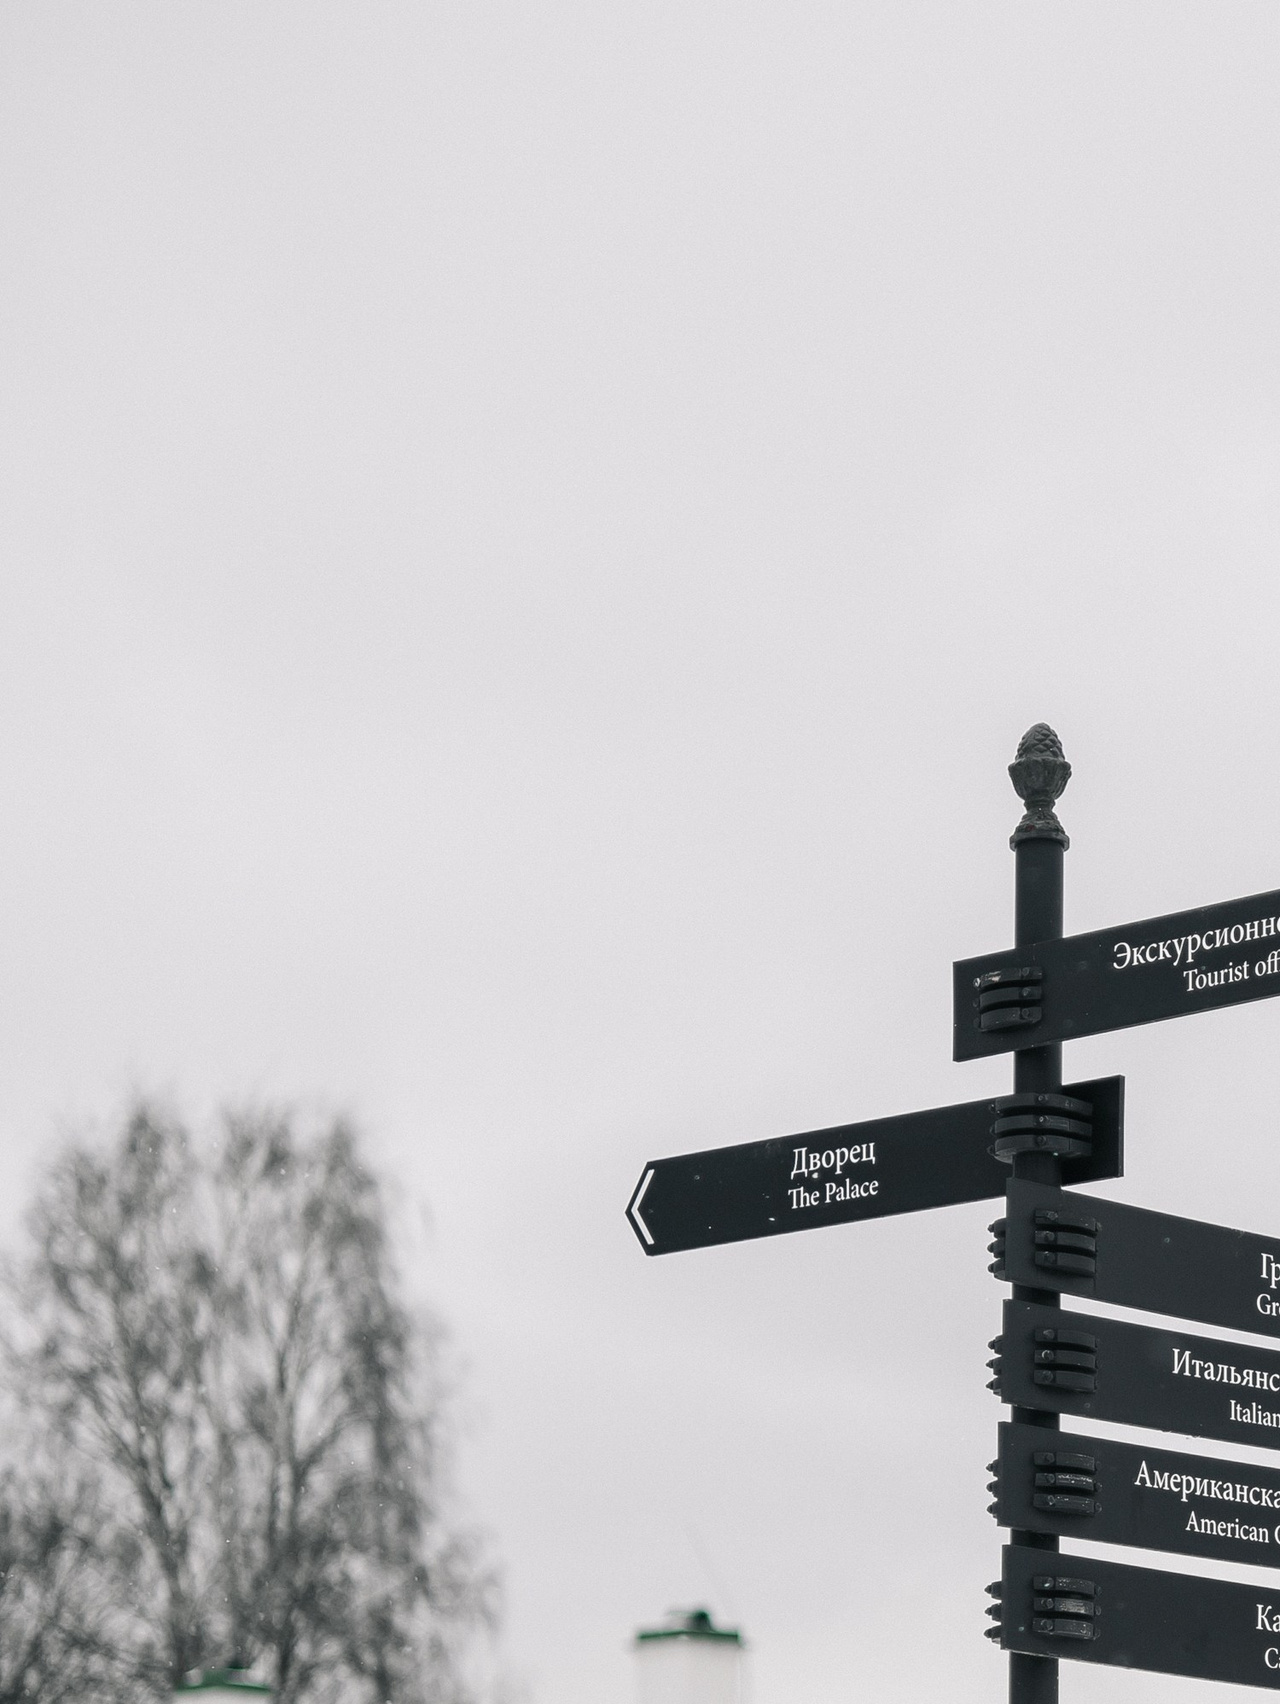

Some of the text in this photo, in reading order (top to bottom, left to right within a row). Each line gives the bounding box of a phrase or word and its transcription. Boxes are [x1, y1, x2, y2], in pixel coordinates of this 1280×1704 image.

[1183, 960, 1250, 992] Tourist
[790, 1142, 876, 1180] Дворец
[787, 1177, 879, 1210] The Palace
[1185, 1510, 1270, 1544] American
